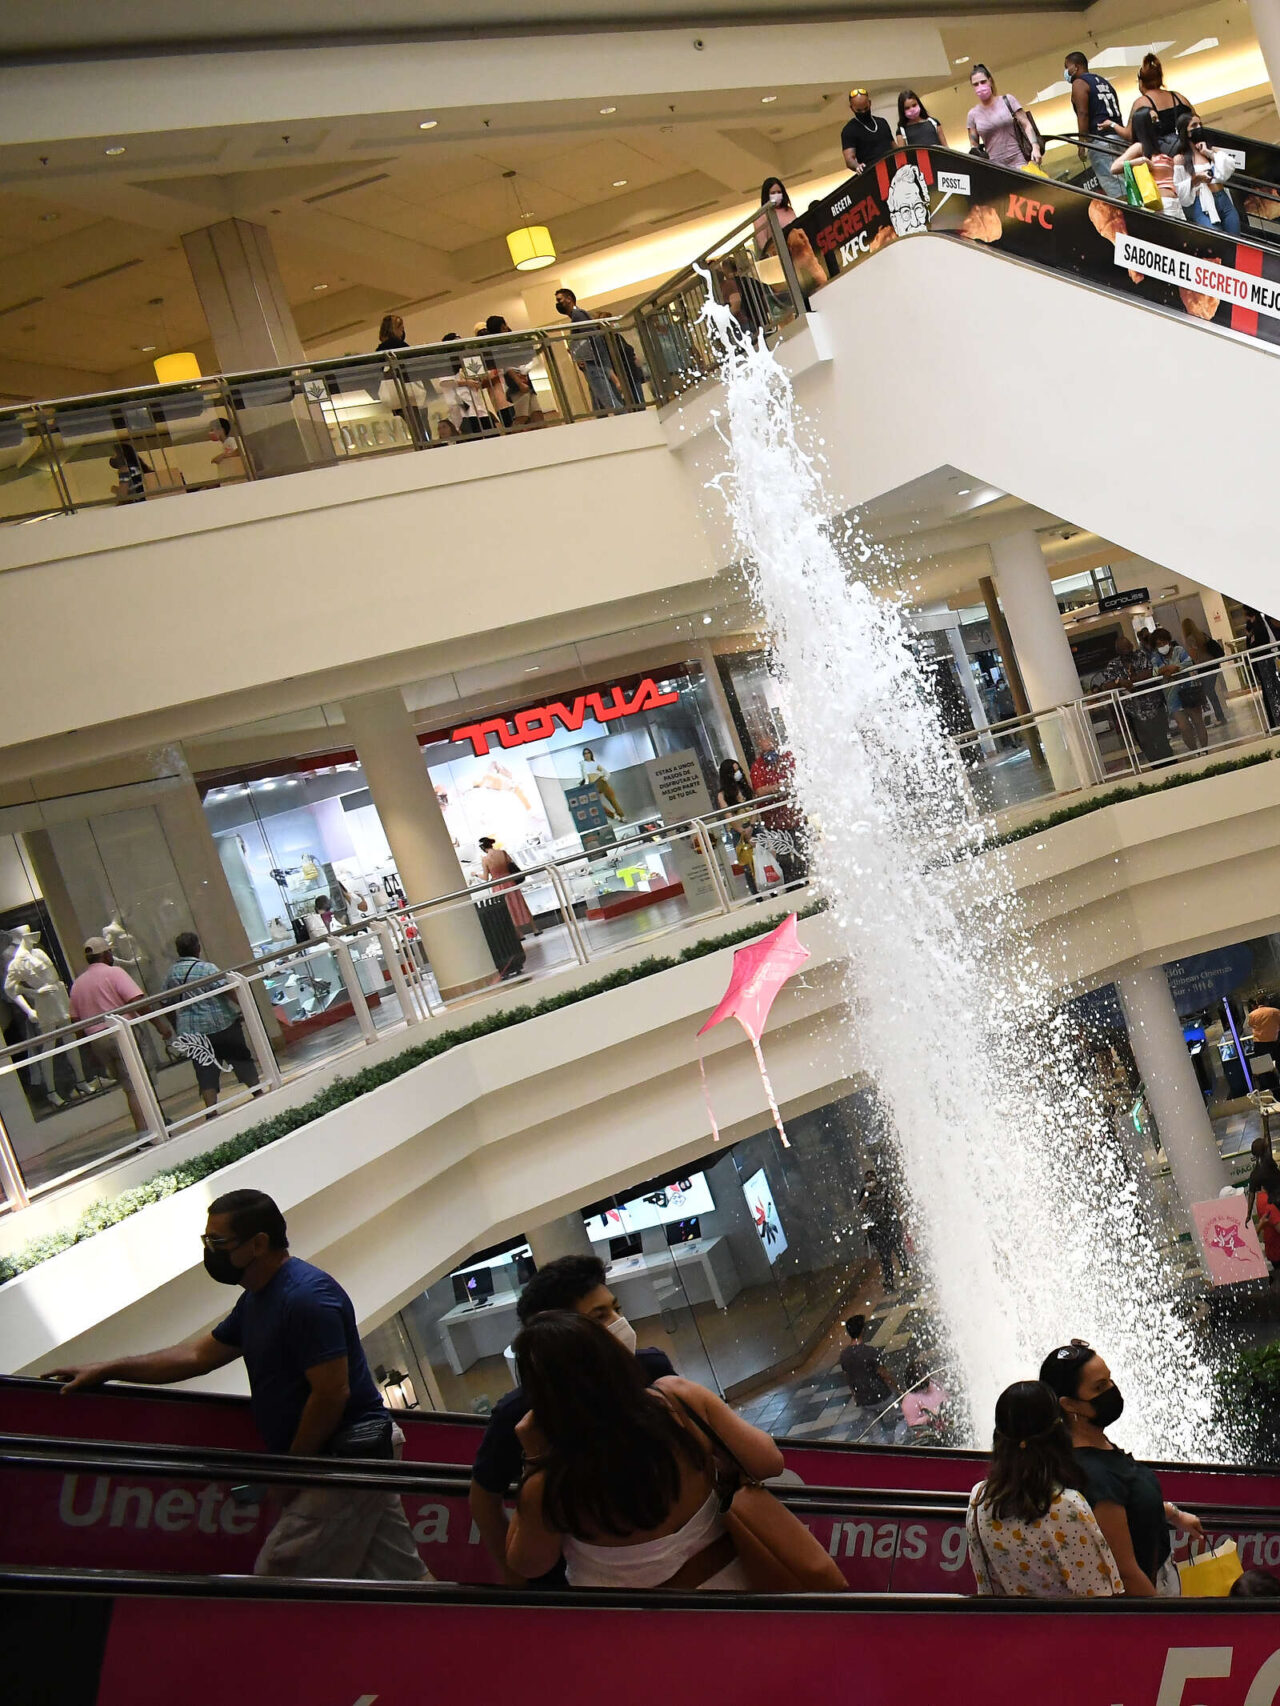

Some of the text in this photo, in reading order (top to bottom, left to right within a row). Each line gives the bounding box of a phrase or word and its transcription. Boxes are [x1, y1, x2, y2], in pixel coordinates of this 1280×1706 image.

[831, 195, 852, 217] RECETA
[1006, 194, 1055, 230] KFC
[816, 195, 881, 255] SECRETA
[839, 231, 870, 267] KFC
[1123, 243, 1176, 277] SABOREA
[1179, 261, 1192, 282] EL
[1195, 266, 1248, 300] SECRETO
[659, 777, 691, 789] DISFRUTAR
[678, 762, 695, 770] UNOS
[662, 781, 700, 795] MEJOR PARTE
[829, 1521, 928, 1560] mas
